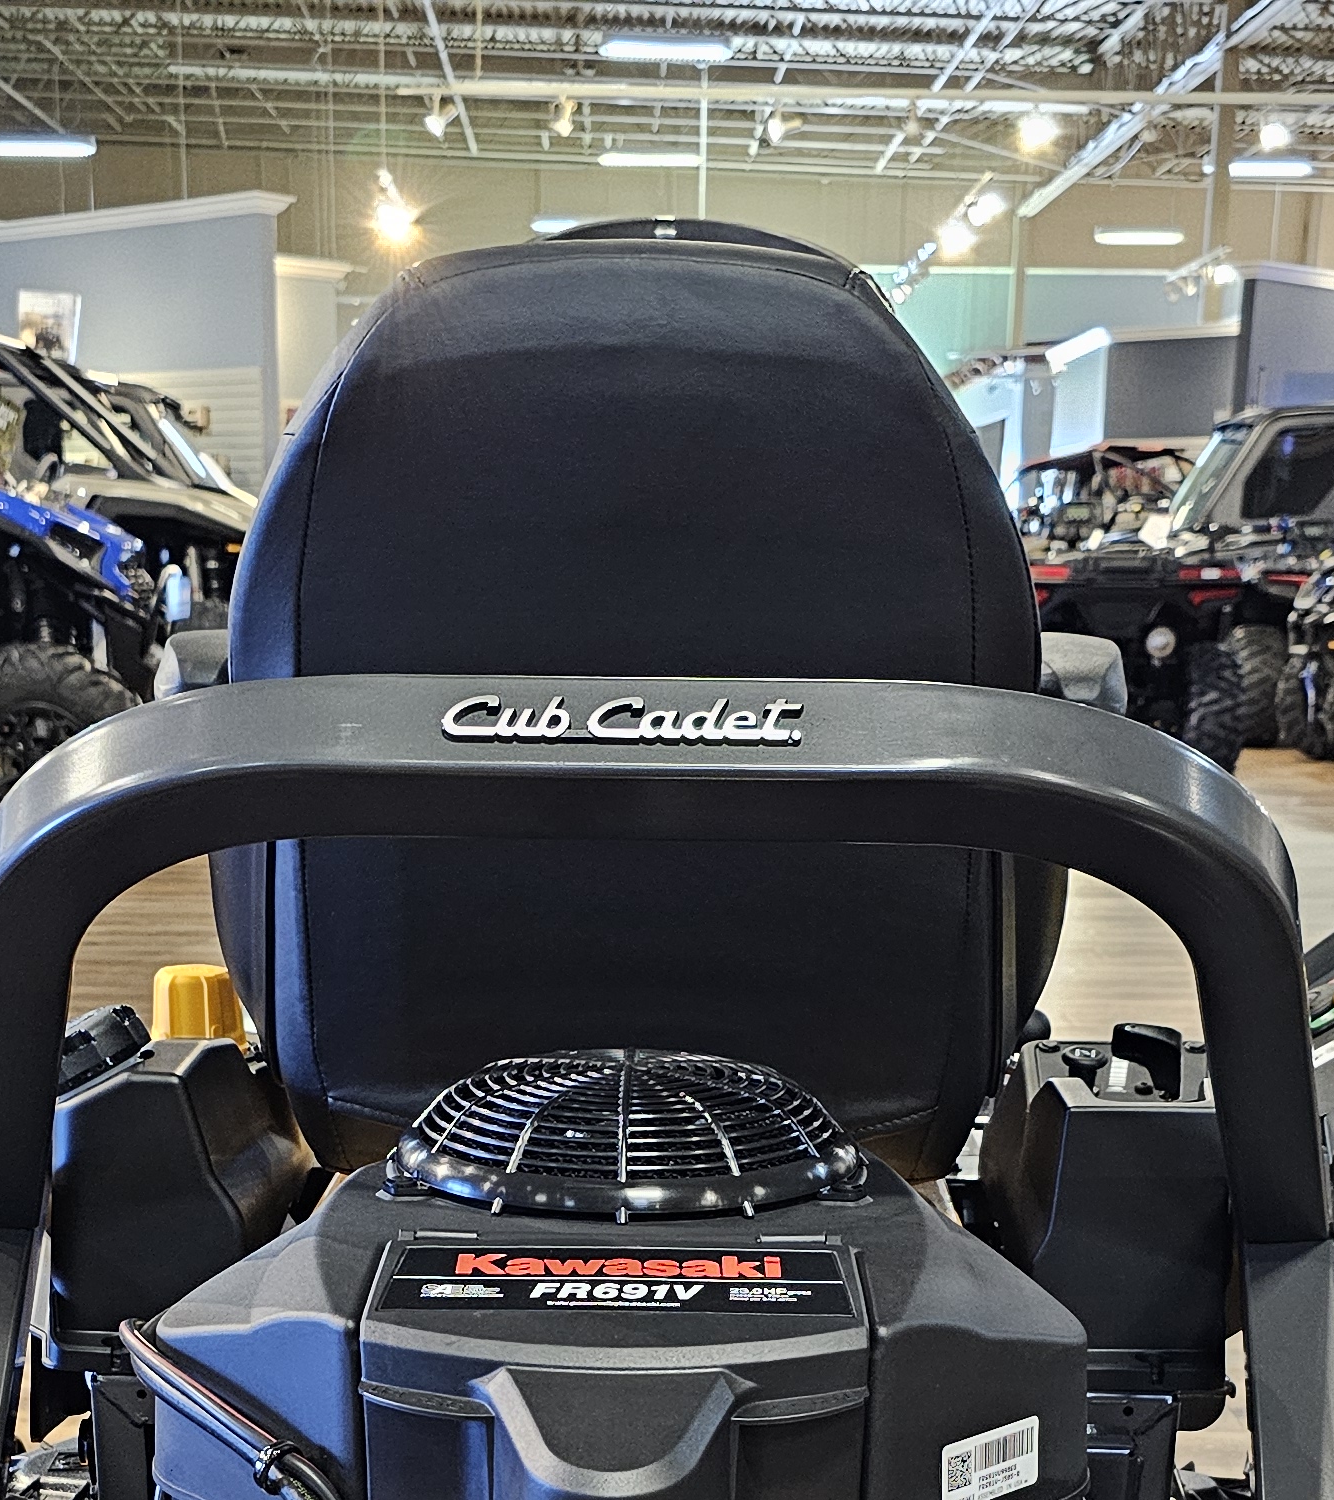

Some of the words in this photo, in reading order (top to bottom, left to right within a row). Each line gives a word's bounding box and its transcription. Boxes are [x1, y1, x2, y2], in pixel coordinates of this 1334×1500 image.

[442, 694, 571, 740] Cub
[455, 1253, 782, 1278] Kawasaki
[529, 1282, 704, 1300] FR691V
